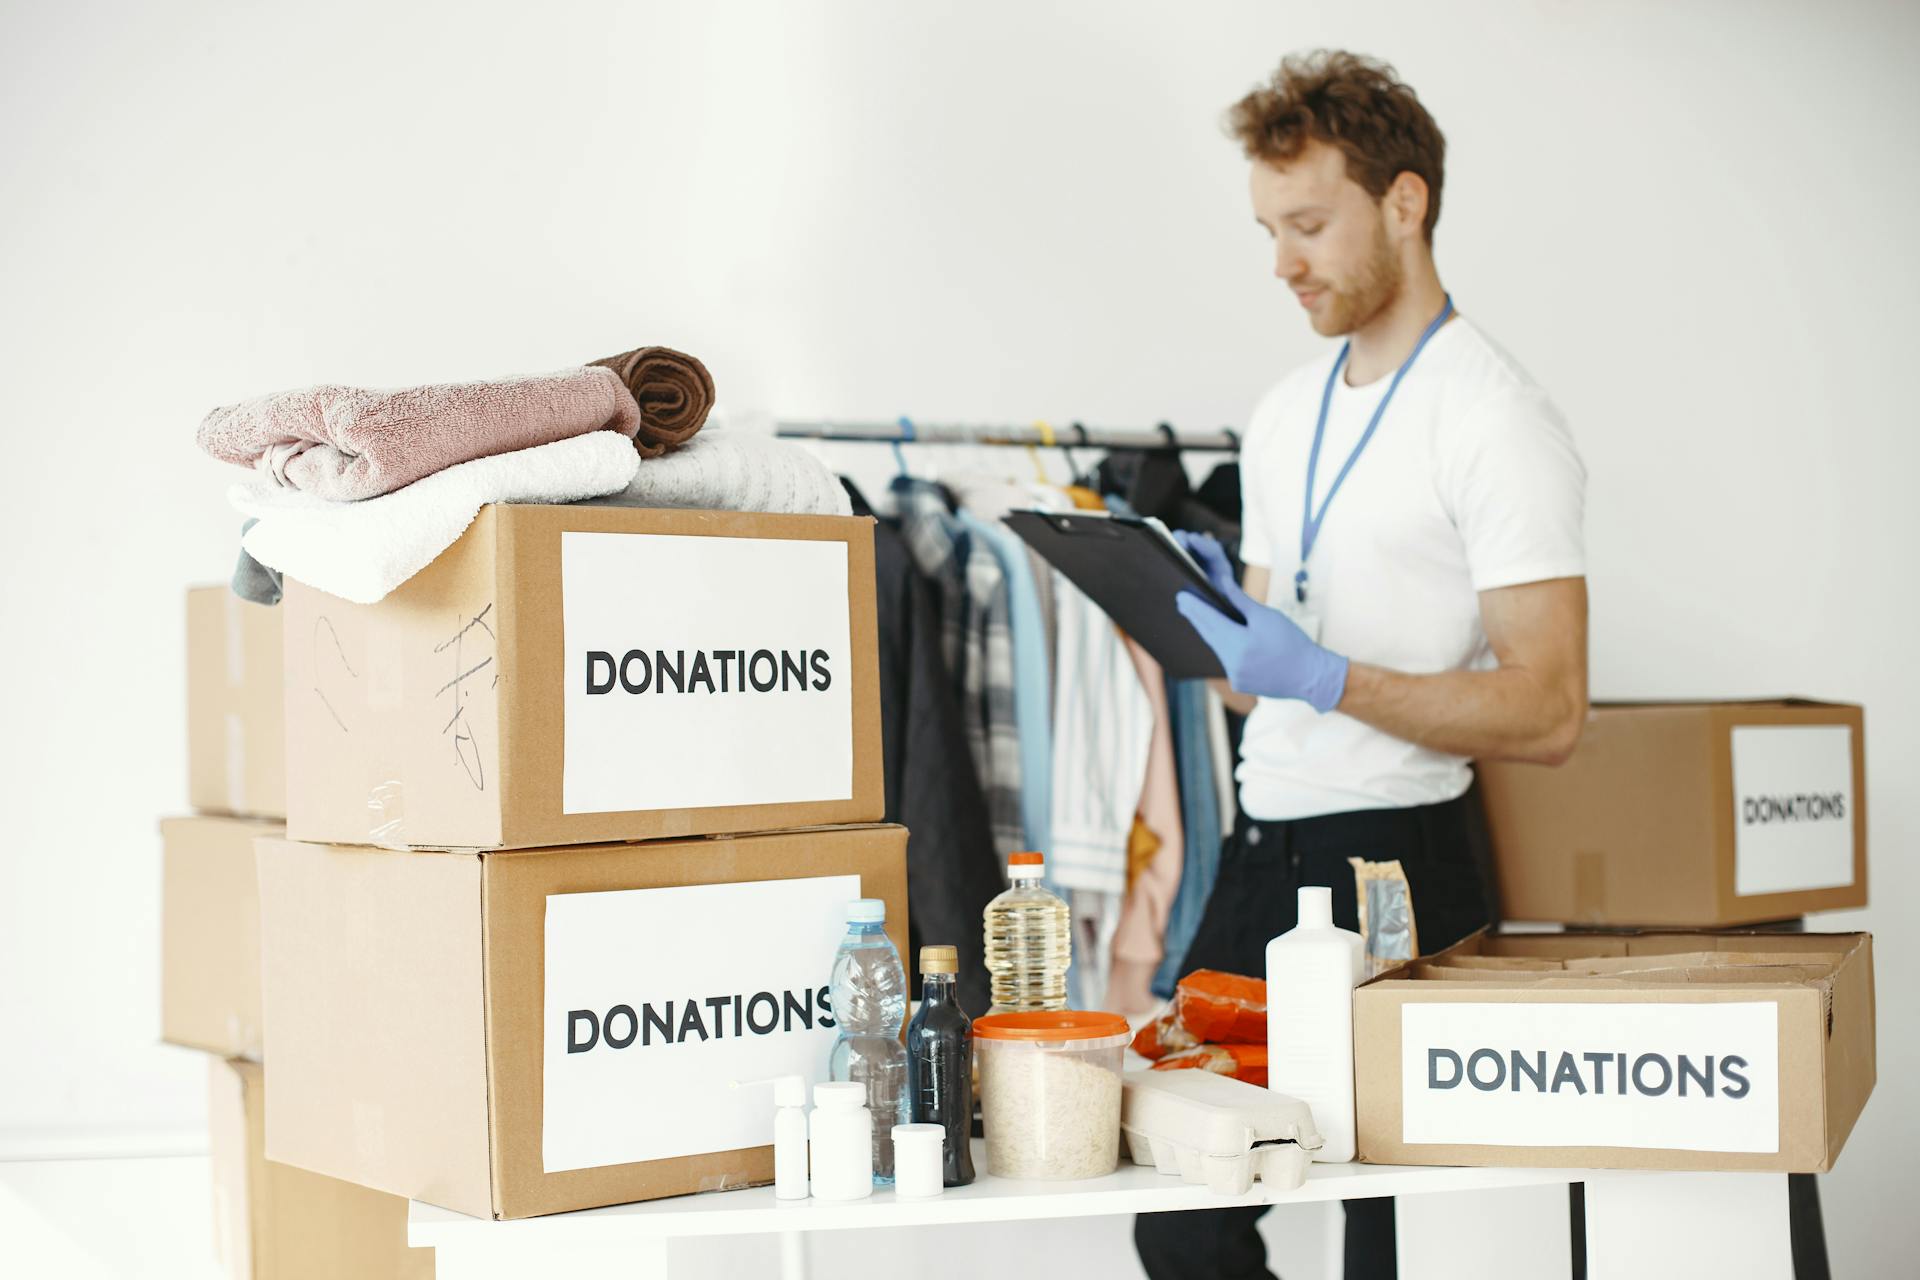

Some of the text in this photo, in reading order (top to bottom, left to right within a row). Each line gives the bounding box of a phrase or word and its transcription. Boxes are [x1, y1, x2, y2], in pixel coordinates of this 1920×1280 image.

[586, 648, 832, 696] DONATIONS
[1744, 792, 1844, 824] DONATIONS
[567, 985, 836, 1054] DONATIONS
[1428, 1047, 1750, 1100] DONATIONS
